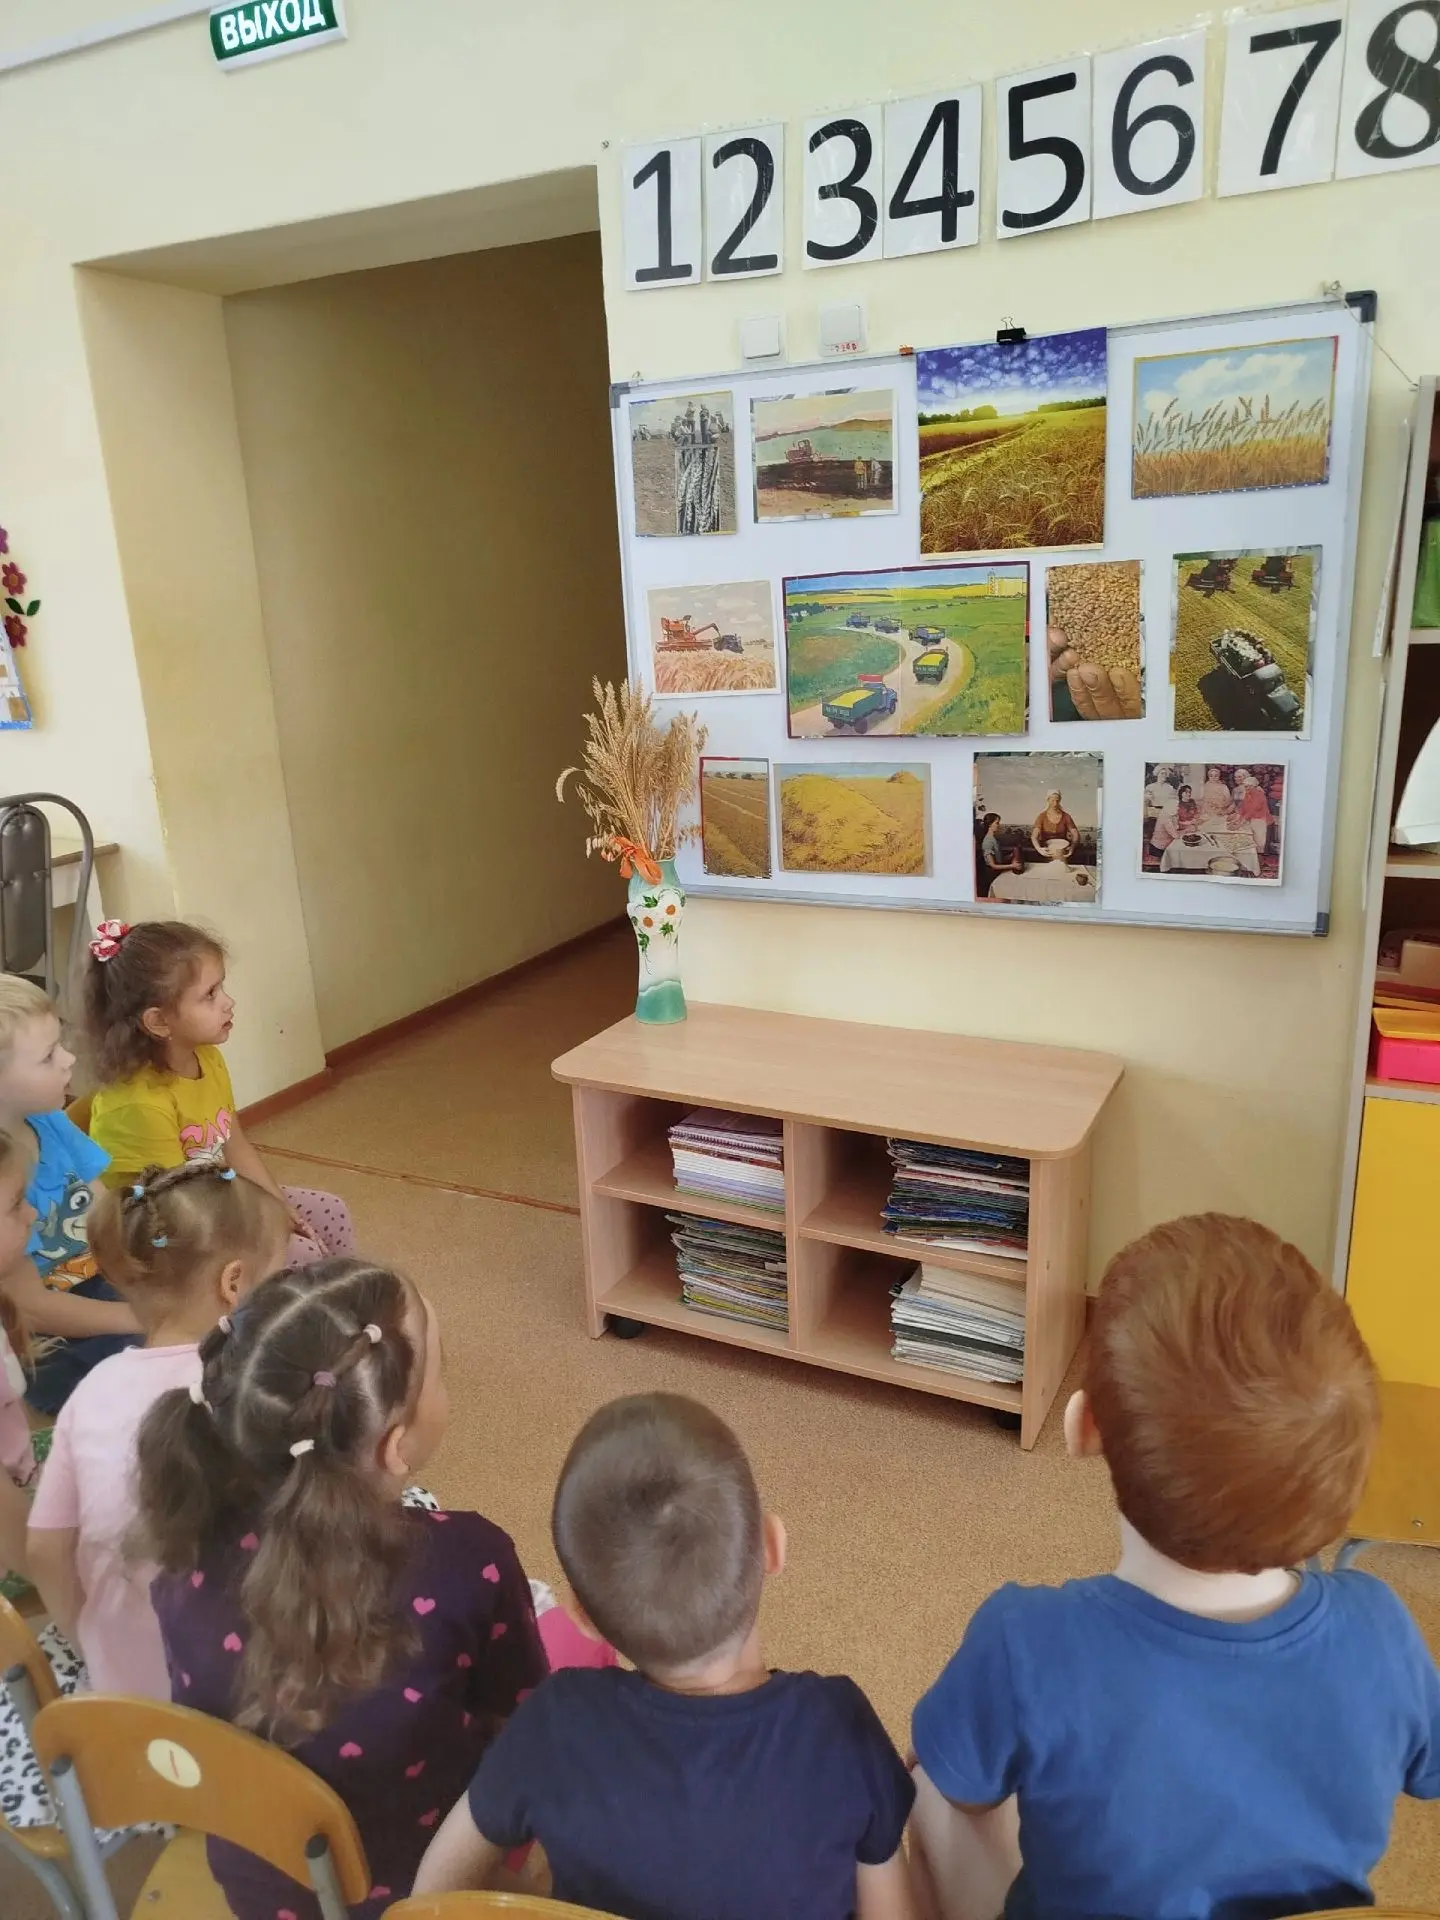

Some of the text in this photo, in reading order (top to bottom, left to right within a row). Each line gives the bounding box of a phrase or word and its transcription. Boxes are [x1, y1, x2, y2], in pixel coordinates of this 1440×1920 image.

[219, 0, 328, 51] ВЫХОД
[633, 0, 1440, 282] 1 2 3 4 5 6 7 8
